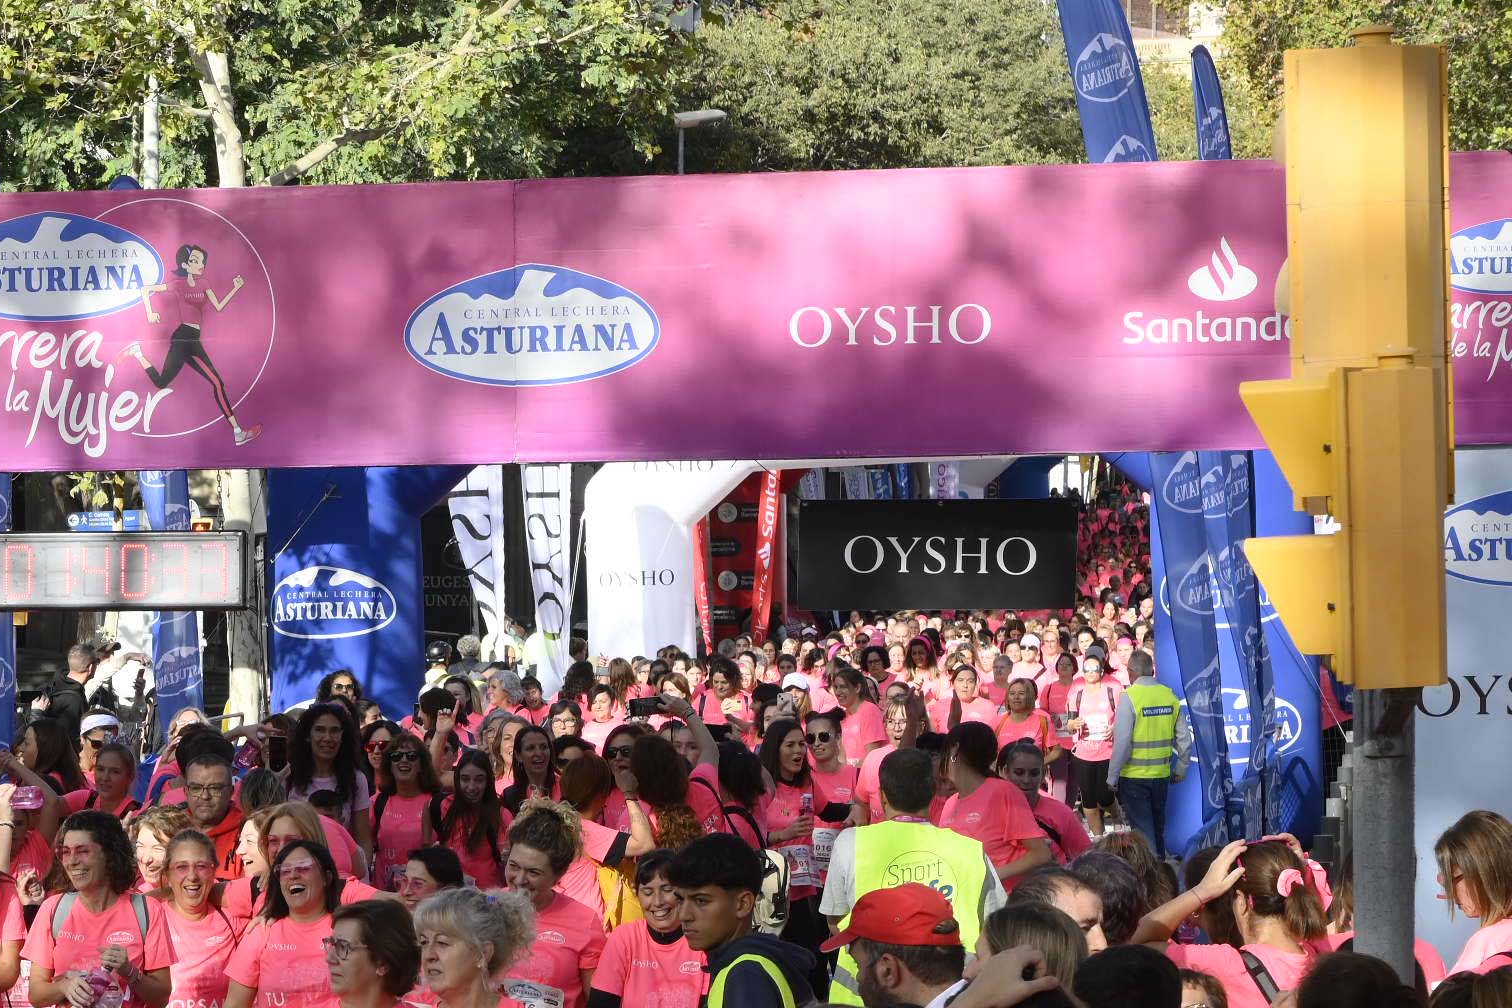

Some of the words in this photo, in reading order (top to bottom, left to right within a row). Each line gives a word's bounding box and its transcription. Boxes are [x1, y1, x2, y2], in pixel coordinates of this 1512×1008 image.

[67, 248, 140, 260] LECHERA
[463, 308, 542, 321] CENTRAL
[549, 305, 632, 318] LECHERA
[425, 311, 639, 357] ASTURIANA
[788, 302, 992, 349] OYSHO
[5, 373, 29, 412] la
[24, 363, 173, 458] Mujer
[843, 534, 1038, 576] OYSHO
[598, 568, 676, 587] OYSHO
[286, 591, 329, 600] CENTRAL
[334, 590, 383, 600] LECHERA
[273, 600, 389, 624] ASTURIANA
[265, 991, 286, 1008] TU
